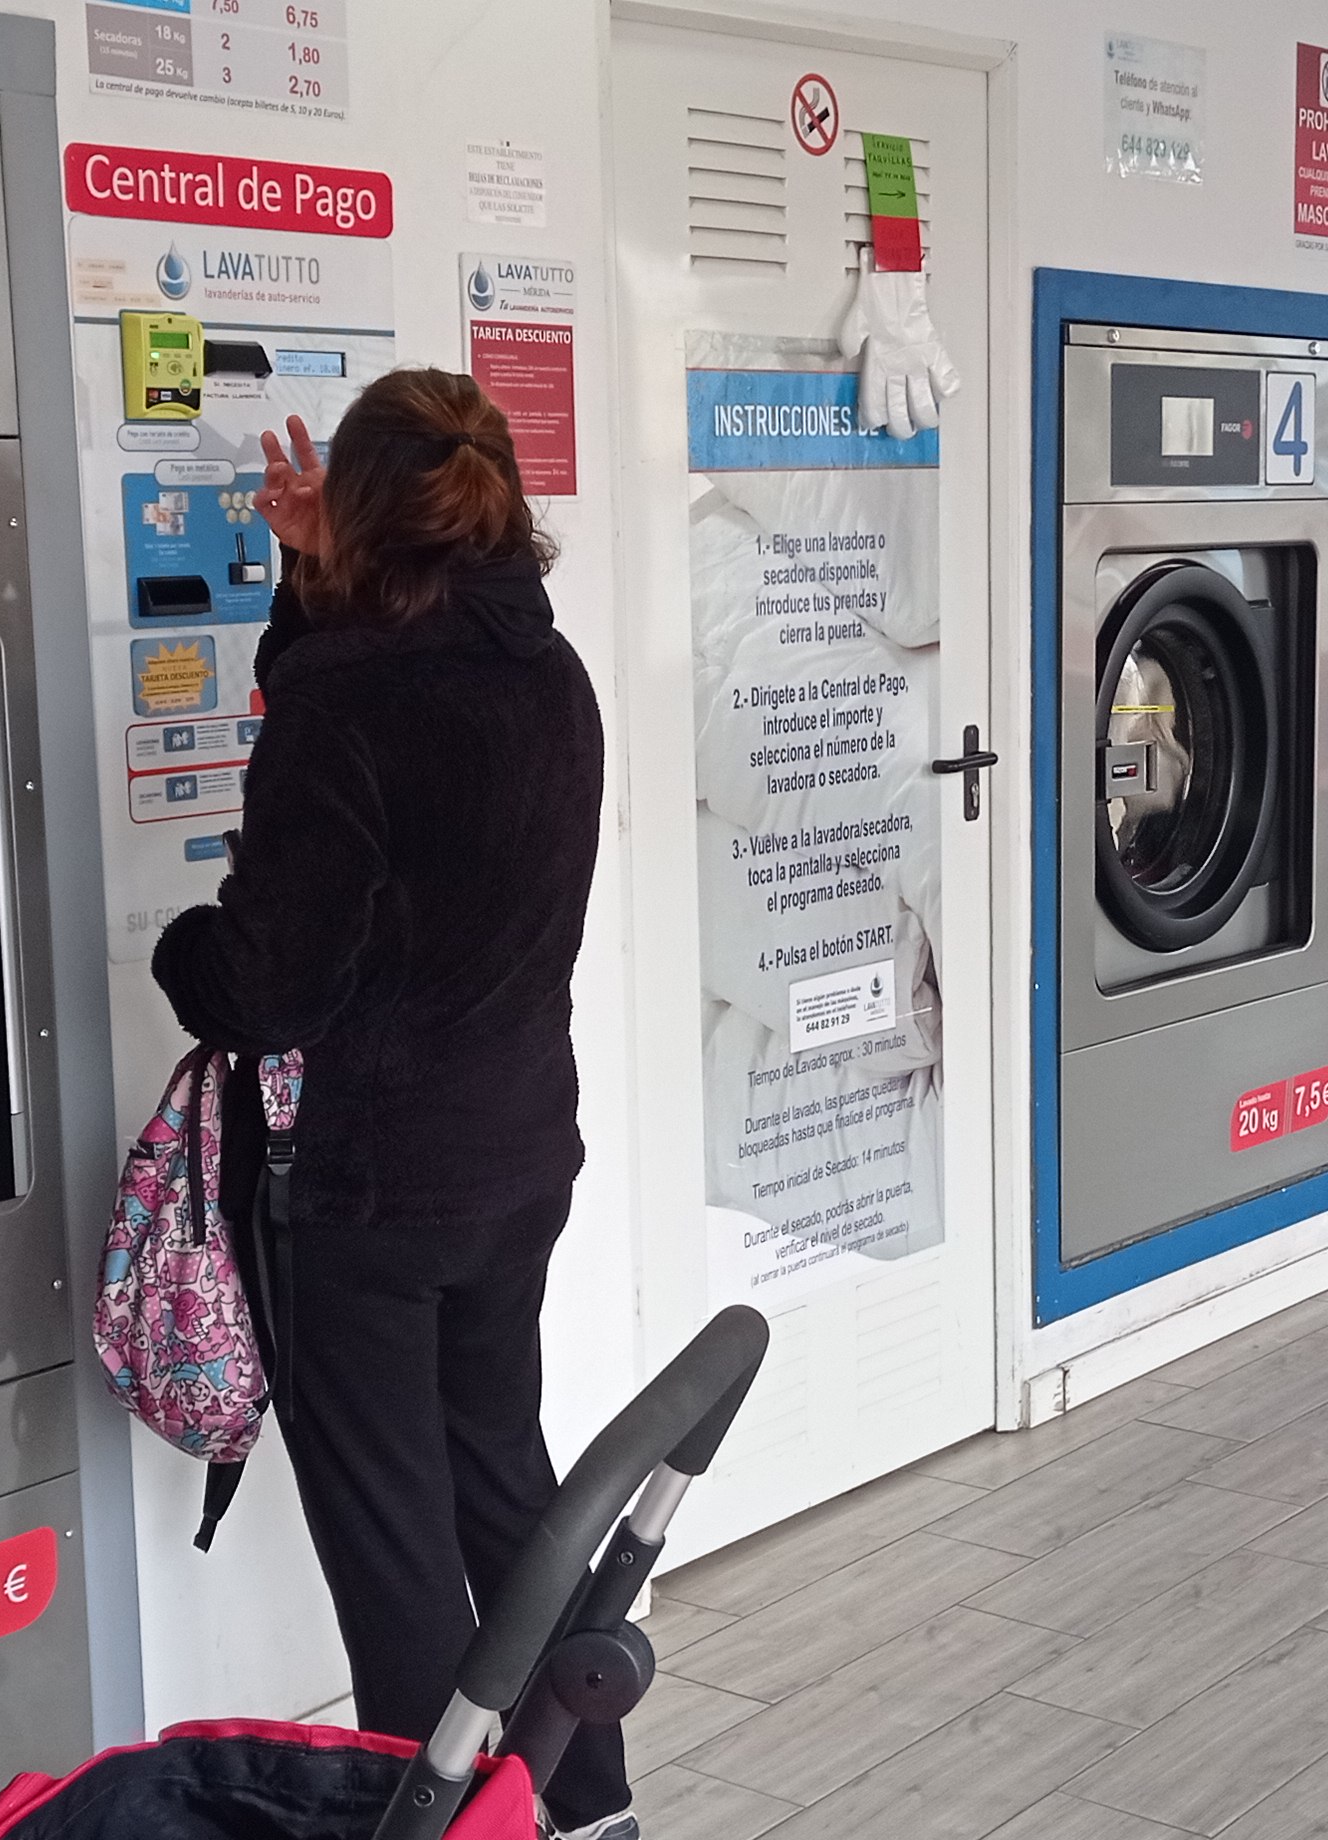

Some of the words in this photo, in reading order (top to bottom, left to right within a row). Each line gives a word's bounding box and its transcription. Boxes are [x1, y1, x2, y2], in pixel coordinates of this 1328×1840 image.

[286, 5, 318, 28] 6,75
[93, 29, 143, 47] Secadoras
[155, 24, 172, 40] 18
[221, 33, 231, 50] 2
[155, 58, 173, 76] 25
[287, 42, 320, 65] 1,80
[222, 66, 232, 84] 3
[288, 75, 321, 98] 2,70
[1114, 69, 1147, 90] Teléfono
[1149, 78, 1158, 91] de
[1160, 79, 1190, 97] atención
[95, 79, 104, 90] La
[105, 80, 133, 93] central
[133, 84, 143, 95] de
[144, 86, 164, 98] pago
[165, 87, 198, 102] devuelve
[199, 92, 225, 105] cambio
[254, 99, 279, 112] billetes
[280, 103, 289, 114] de
[84, 153, 225, 208] Central
[237, 166, 282, 212] de
[295, 173, 377, 228] Pago
[202, 250, 321, 285] LAVATUTTO
[498, 263, 574, 283] LAVATUTTO
[204, 288, 254, 301] lavanderías
[255, 291, 266, 301] de
[268, 292, 321, 305] auto-servicio
[472, 326, 512, 341] TARJETA
[515, 329, 571, 344] DESCUENTO
[714, 405, 852, 437] INSTRUCCIONES
[1221, 423, 1241, 433] FAGOR
[1273, 381, 1308, 476] 4
[773, 533, 802, 559] Elige
[805, 536, 825, 552] una
[828, 531, 875, 551] lavadora
[763, 566, 816, 586] secadora
[819, 559, 879, 585] disponible,
[756, 595, 810, 616] introduce
[813, 593, 831, 612] tus
[833, 589, 878, 615] prendas
[779, 624, 812, 645] cierra
[815, 621, 825, 641] la
[828, 622, 866, 645] puerta.
[751, 685, 796, 710] Dirígete
[808, 681, 818, 700] la
[821, 676, 861, 699] Central
[862, 676, 876, 695] de
[879, 673, 909, 697] Pago,
[763, 712, 817, 736] introduce
[820, 708, 830, 729] el
[832, 705, 874, 729] importe
[750, 744, 811, 768] selecciona
[813, 738, 824, 758] el
[826, 736, 868, 757] número
[870, 733, 884, 750] de
[767, 771, 816, 795] lavadora
[828, 761, 881, 786] secadora.
[749, 833, 788, 857] Vuelve
[800, 828, 811, 848] la
[813, 813, 913, 846] lavadora/secadora,
[748, 865, 773, 887] toca
[775, 862, 786, 882] la
[788, 855, 832, 884] pantalla
[844, 843, 901, 869] selecciona
[767, 892, 777, 913] el
[780, 882, 834, 915] programa
[836, 873, 884, 900] deseado.
[775, 946, 807, 970] Pulsa
[809, 941, 819, 962] el
[822, 933, 854, 957] botón
[856, 925, 894, 951] START.
[806, 1021, 819, 1033] 644
[821, 1018, 829, 1030] 82
[831, 1016, 840, 1027] 91
[841, 1013, 850, 1025] 29
[748, 1067, 781, 1088] Tiempo
[795, 1055, 827, 1075] Lavado
[874, 1033, 906, 1054] minutos
[745, 1113, 781, 1134] Durante
[792, 1101, 823, 1120] lavado,
[839, 1086, 870, 1110] puertas
[1239, 1107, 1259, 1136] 20
[1263, 1108, 1278, 1131] kg
[738, 1133, 790, 1159] bloqueadas
[791, 1124, 815, 1142] hasta
[835, 1109, 864, 1127] finalice
[875, 1095, 915, 1120] programa.
[752, 1180, 785, 1199] Tiempo
[787, 1169, 811, 1189] inicial
[825, 1157, 859, 1177] Secado:
[874, 1140, 905, 1161] minutos
[744, 1227, 779, 1248] Durante
[791, 1211, 823, 1230] secado,
[826, 1200, 854, 1224] podrás
[775, 1238, 809, 1260] verificar
